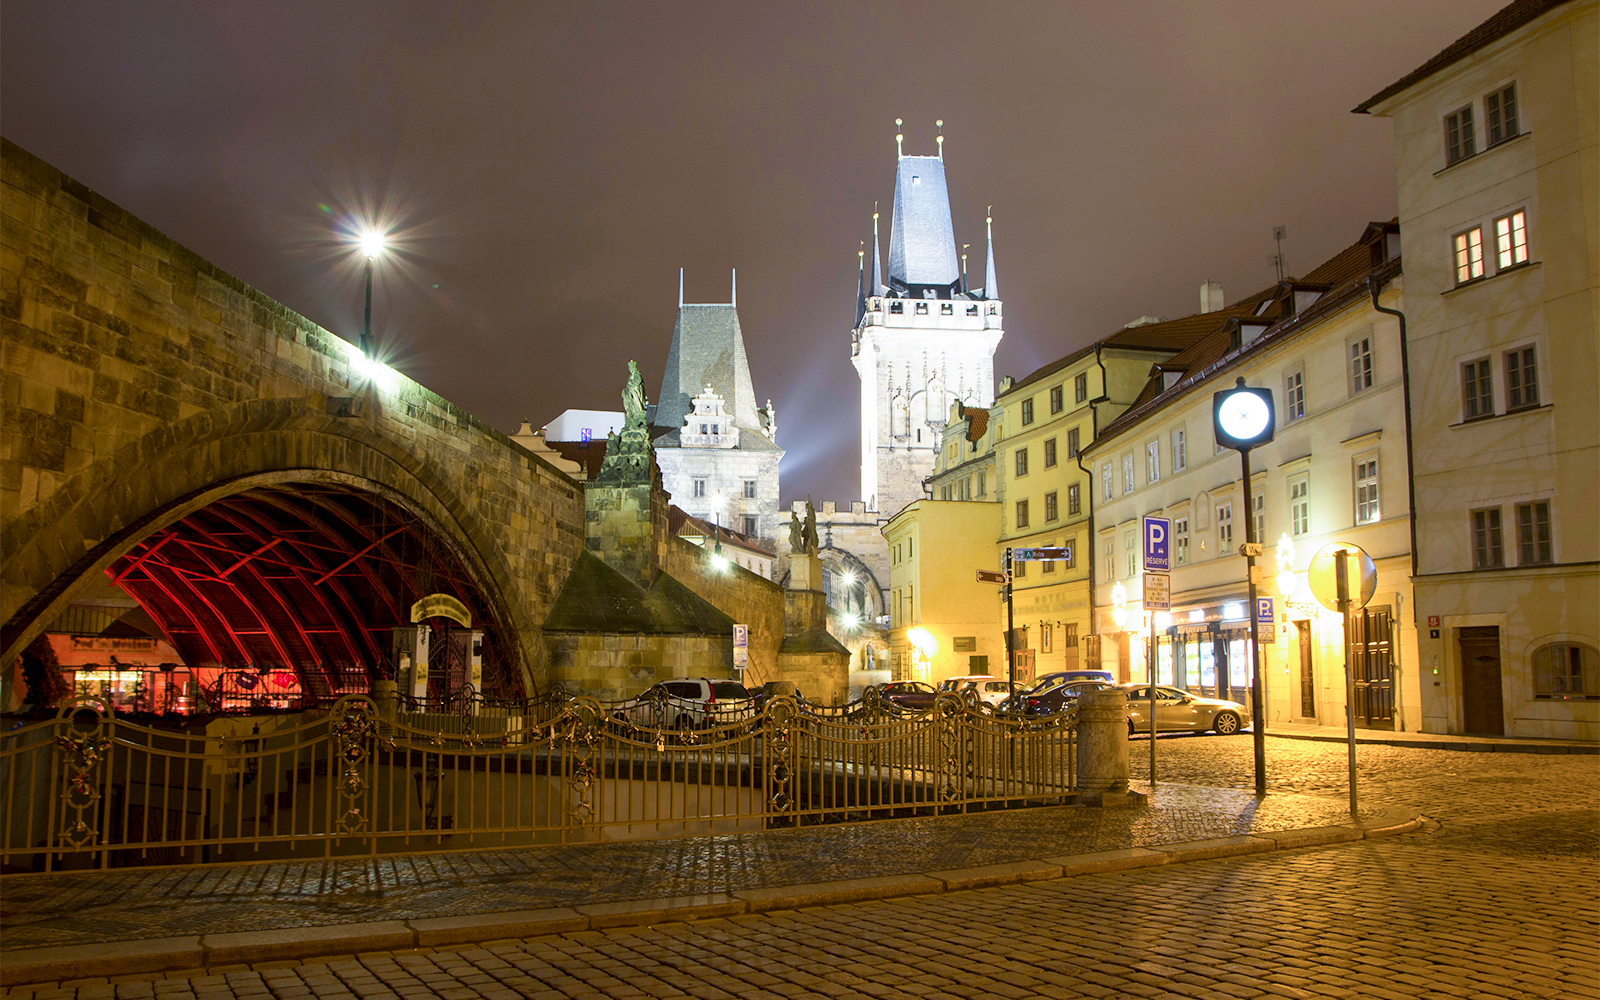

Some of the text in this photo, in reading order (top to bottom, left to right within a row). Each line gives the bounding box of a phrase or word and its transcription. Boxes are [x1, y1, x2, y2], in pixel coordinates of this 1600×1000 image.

[1150, 524, 1165, 554] P
[1259, 600, 1271, 616] P
[736, 627, 745, 641] P
